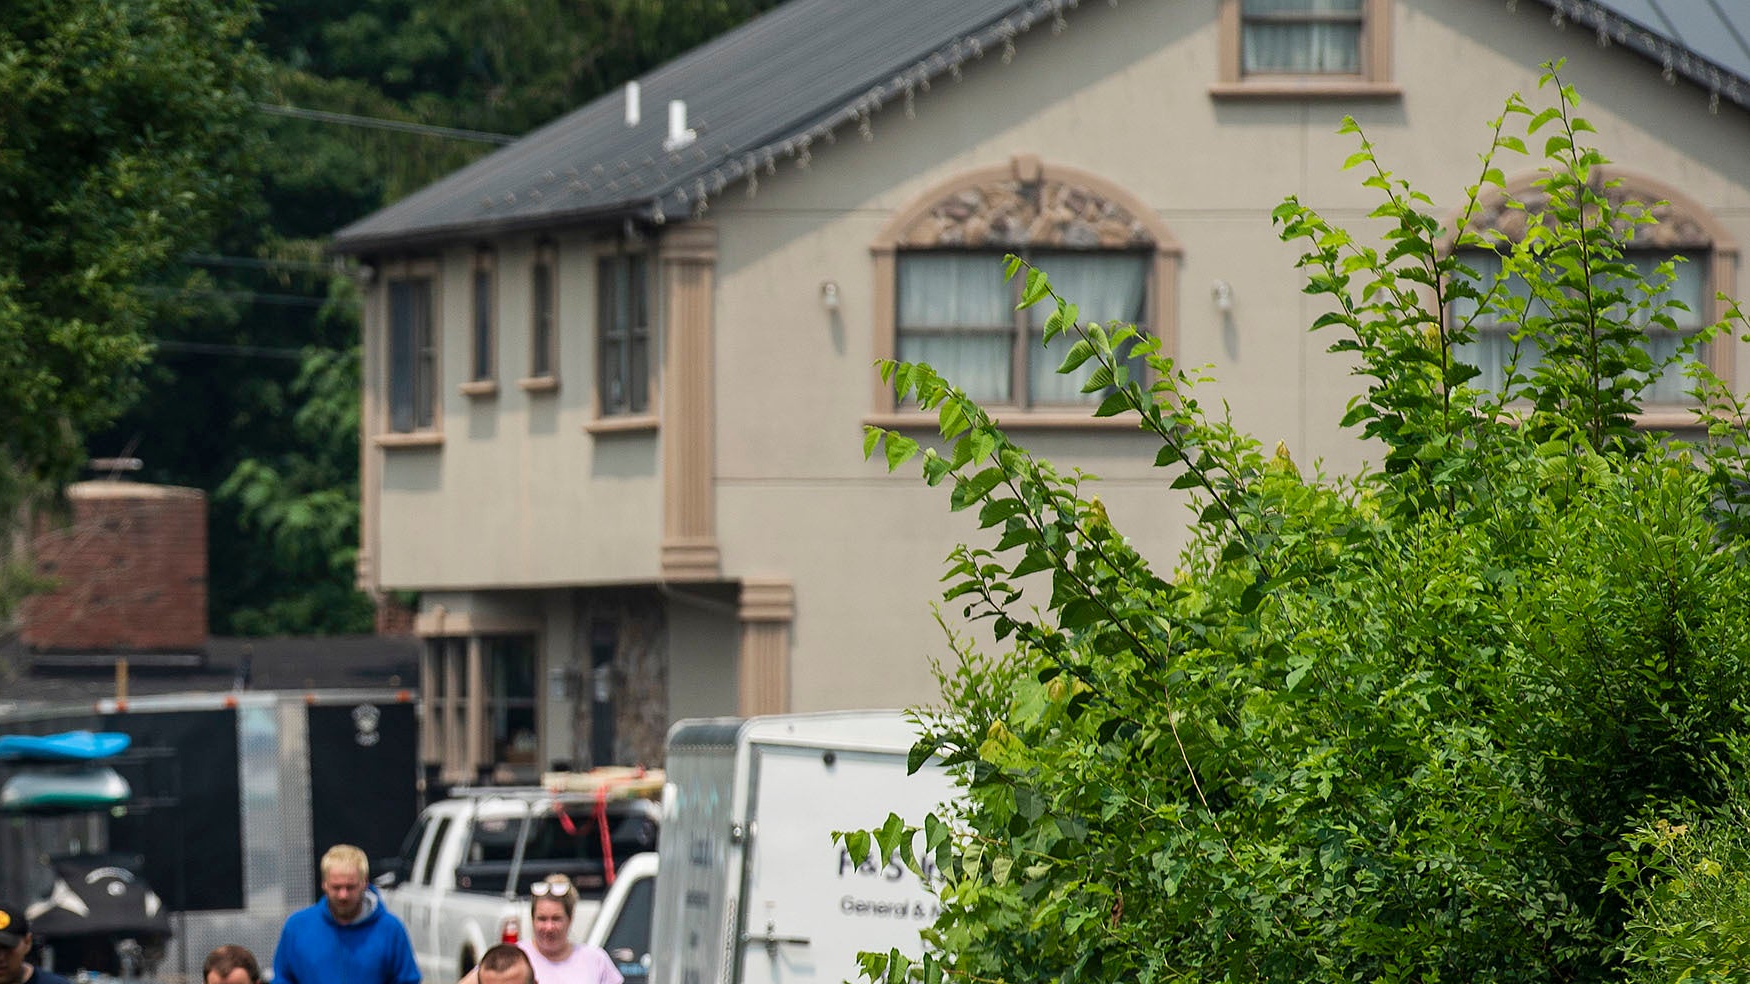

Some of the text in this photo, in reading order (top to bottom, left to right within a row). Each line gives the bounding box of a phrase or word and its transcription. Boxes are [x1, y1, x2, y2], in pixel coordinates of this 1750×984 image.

[884, 849, 903, 882] S
[840, 895, 909, 920] General
[911, 900, 926, 920] &
